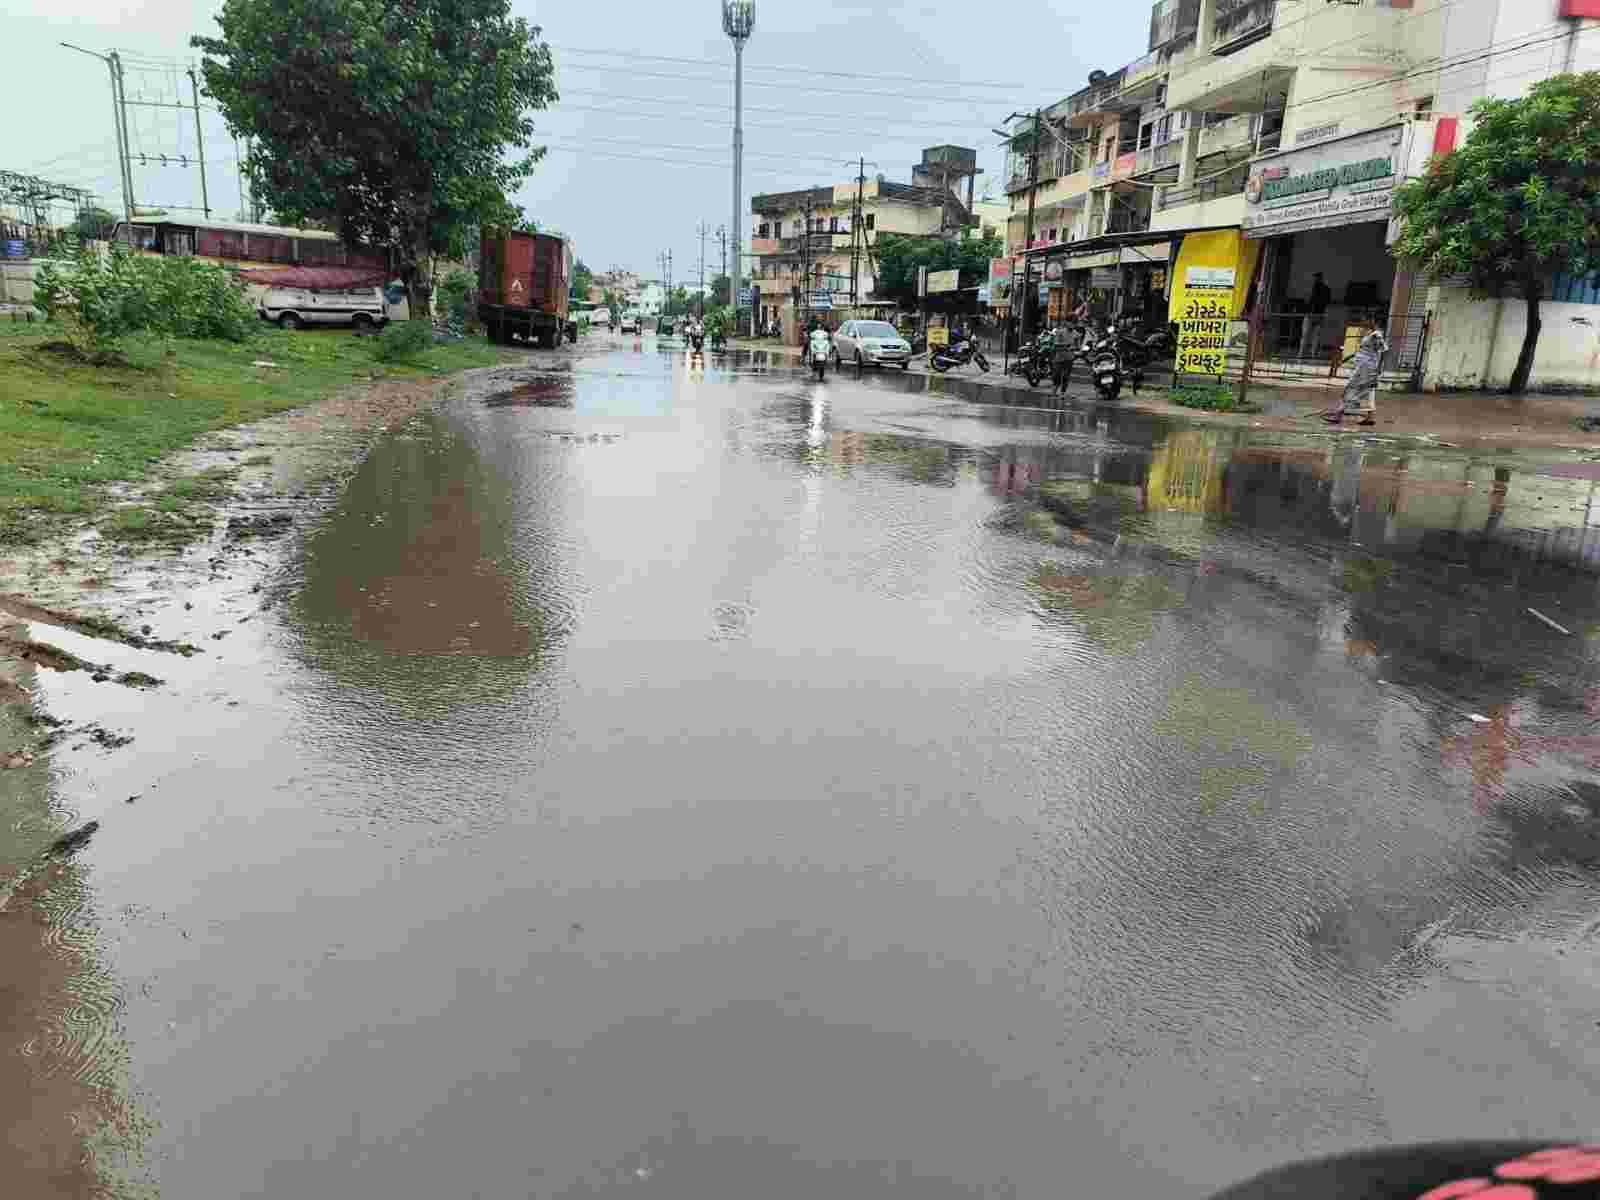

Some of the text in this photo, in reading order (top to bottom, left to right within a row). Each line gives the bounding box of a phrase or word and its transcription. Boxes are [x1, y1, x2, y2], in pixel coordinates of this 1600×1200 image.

[1185, 300, 1226, 319] રોસ્ટેડ
[1183, 320, 1227, 334] ખાખરા
[1182, 336, 1224, 351] ફરસાણ
